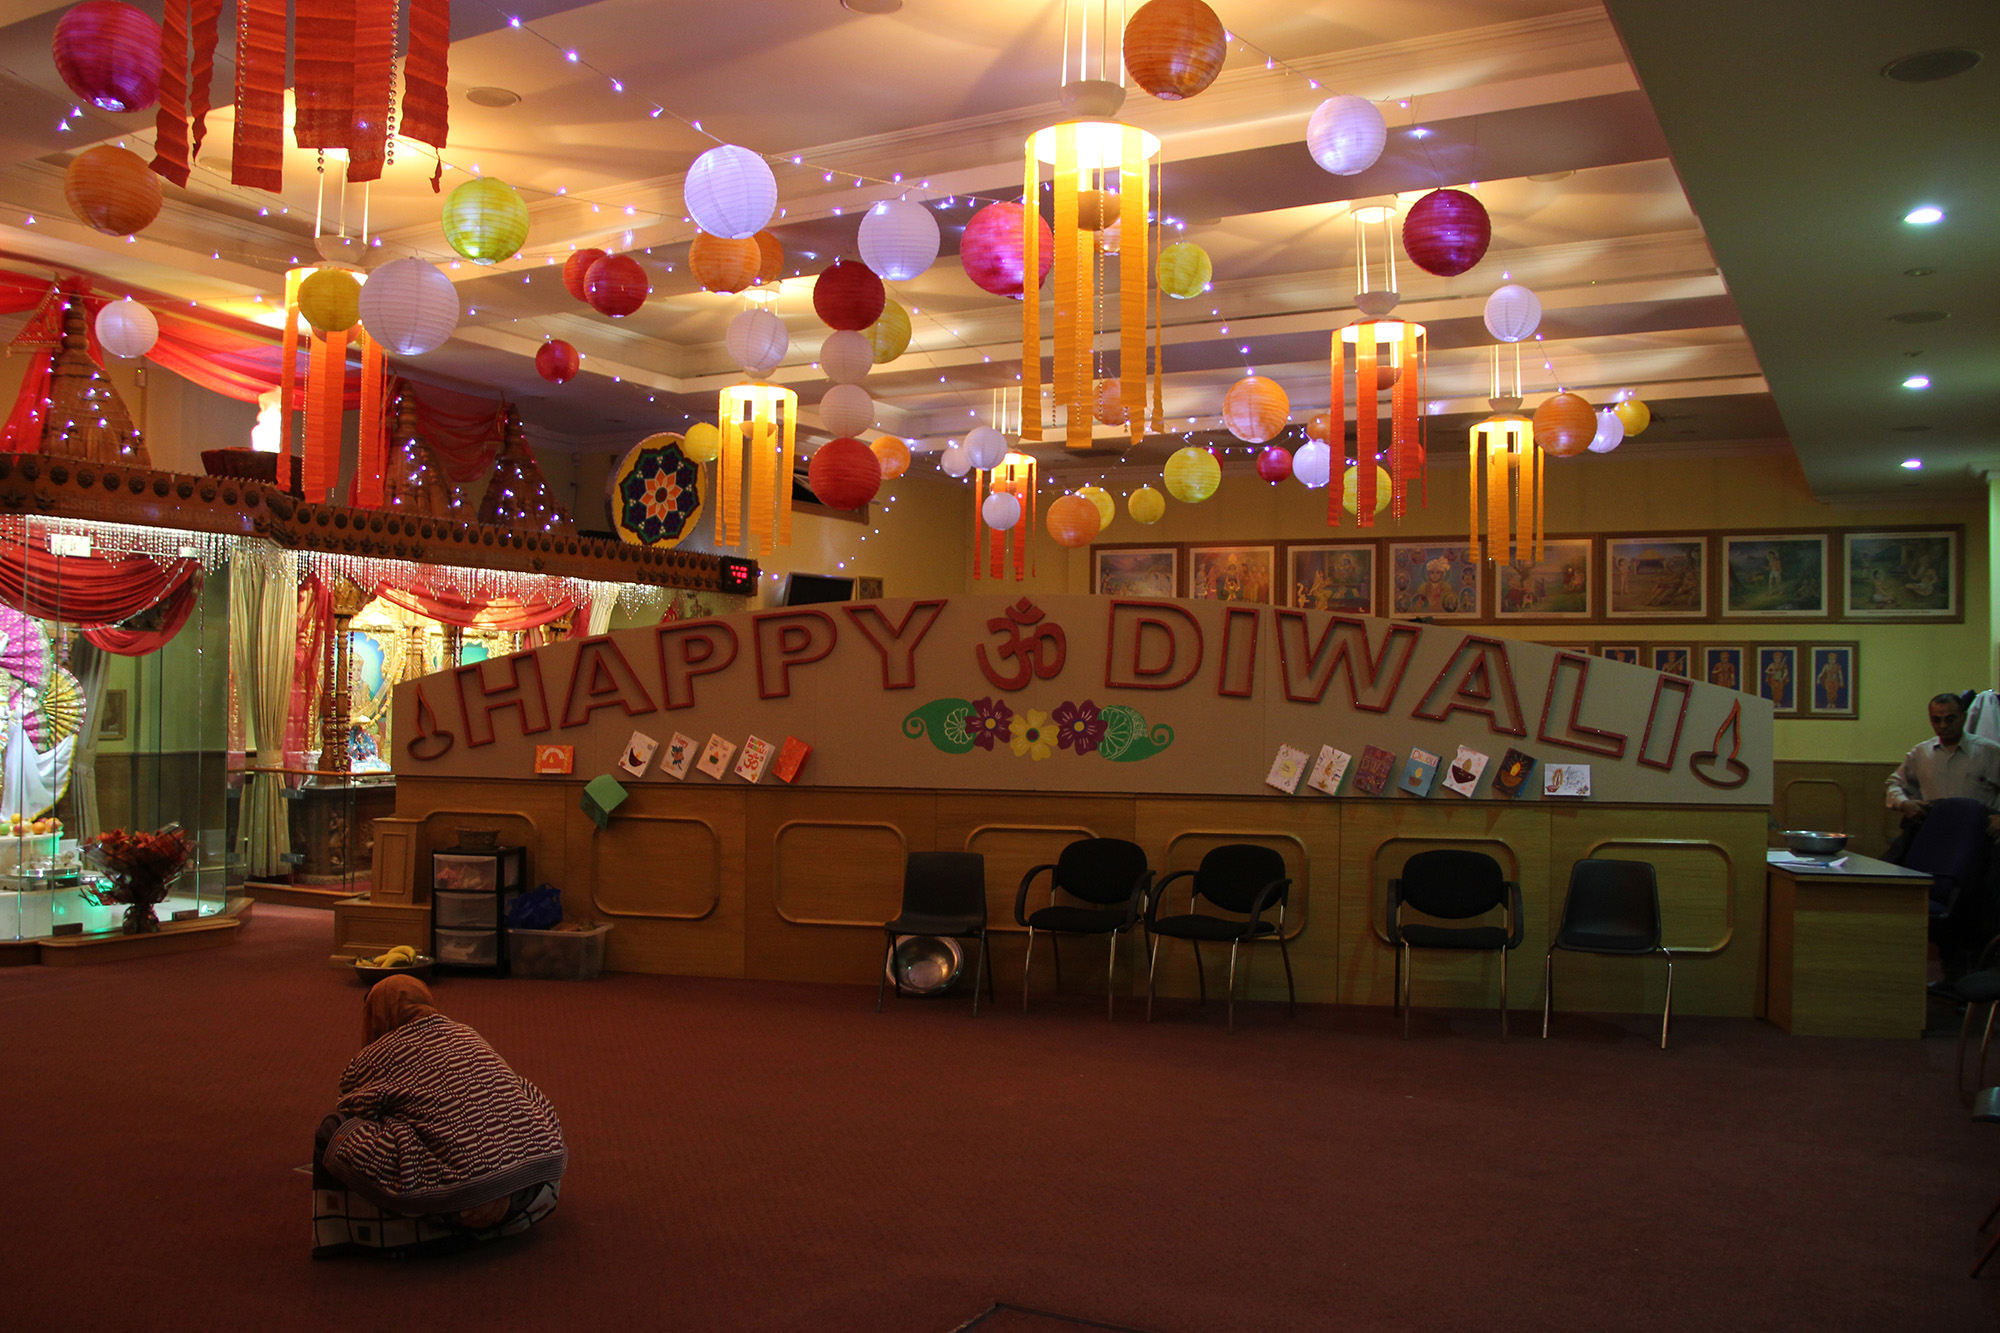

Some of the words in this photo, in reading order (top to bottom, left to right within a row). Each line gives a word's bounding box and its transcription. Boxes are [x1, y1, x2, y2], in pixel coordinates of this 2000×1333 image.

[70, 498, 113, 512] SHREE
[117, 503, 193, 521] GHAHYAM
[454, 599, 948, 748] HAPPY
[1105, 600, 1695, 771] DIWALI
